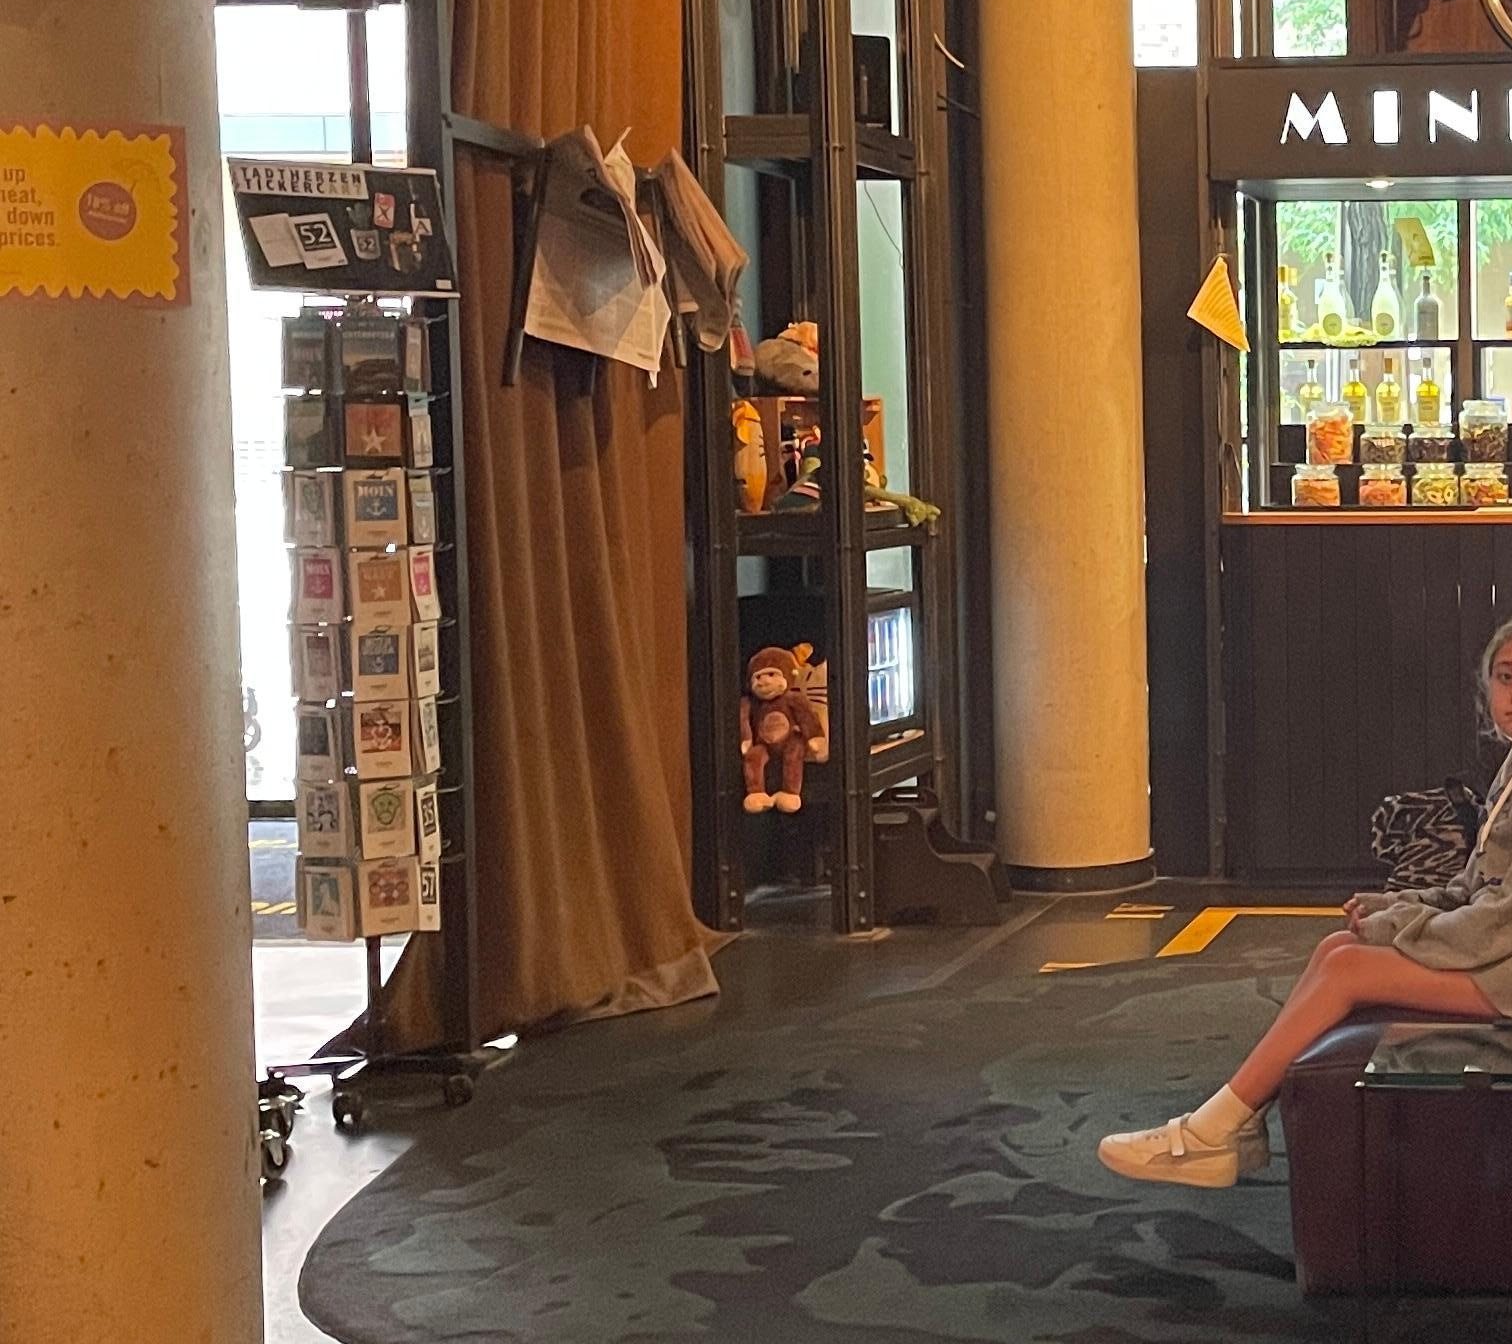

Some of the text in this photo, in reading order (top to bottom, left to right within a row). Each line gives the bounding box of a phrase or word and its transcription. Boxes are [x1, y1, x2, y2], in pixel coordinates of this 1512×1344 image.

[3, 168, 26, 185] up
[7, 207, 54, 225] down
[300, 223, 332, 244] 52
